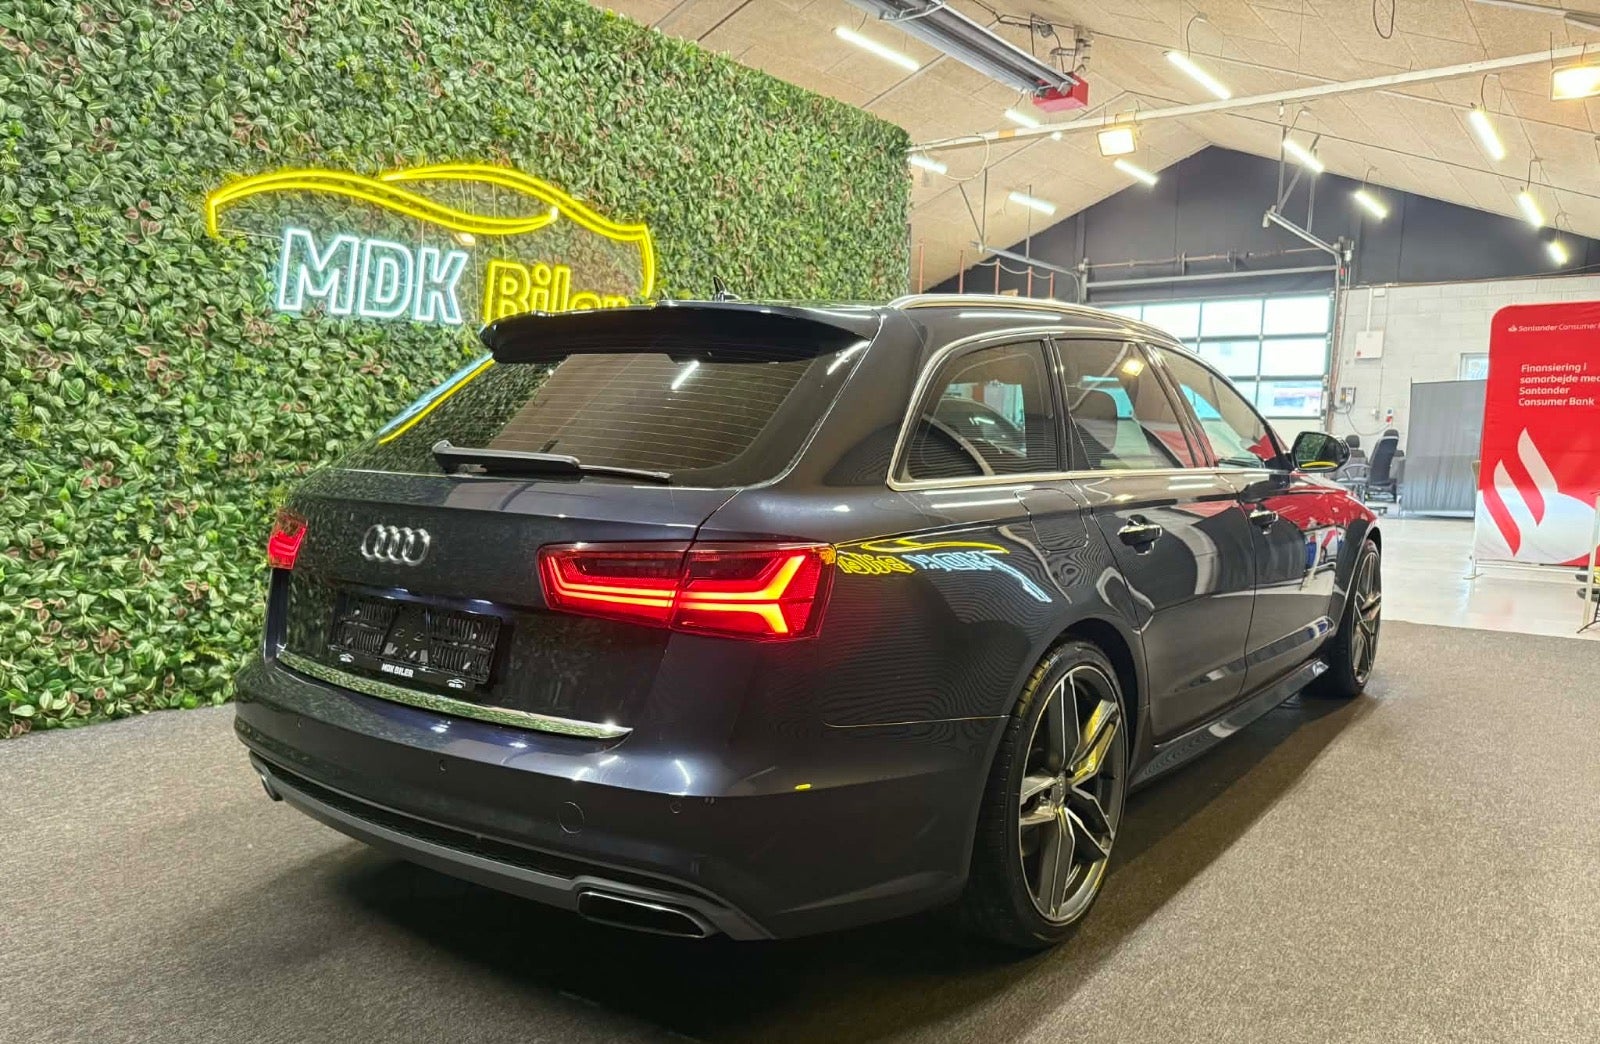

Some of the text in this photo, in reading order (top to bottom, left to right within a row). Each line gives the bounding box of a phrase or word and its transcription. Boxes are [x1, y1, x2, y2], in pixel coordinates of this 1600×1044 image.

[277, 227, 631, 326] MDK Bil
[1558, 323, 1596, 331] Consumer
[1521, 363, 1581, 373] Finansiering
[1520, 374, 1578, 385] samarbejde
[1519, 386, 1570, 395] Santander
[1518, 397, 1595, 406] Consumer Bank
